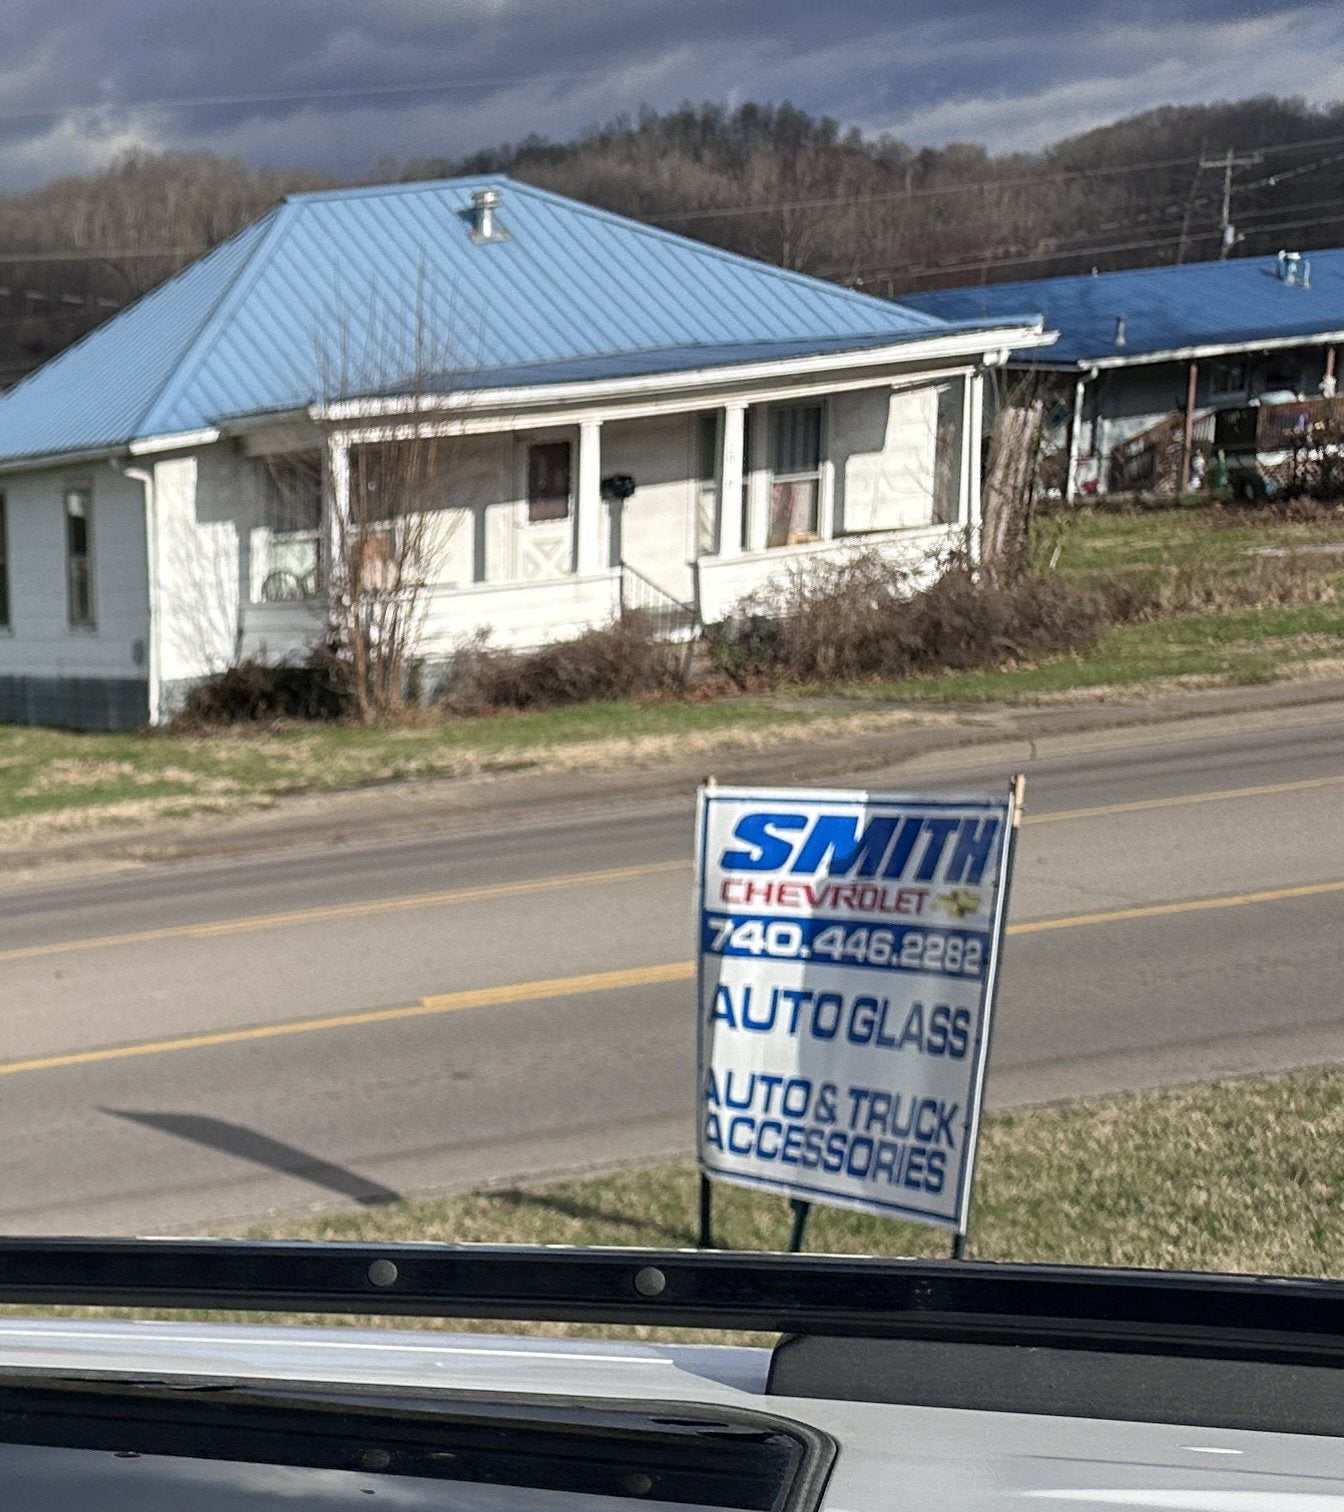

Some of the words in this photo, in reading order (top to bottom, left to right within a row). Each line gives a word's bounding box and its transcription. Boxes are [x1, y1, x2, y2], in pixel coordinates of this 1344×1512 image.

[720, 813, 999, 885] SMITH
[720, 878, 930, 915] CHEVROLET
[708, 917, 982, 971] 740.446.2282
[714, 985, 843, 1040] AUTO
[848, 993, 971, 1058] GLASS
[706, 1069, 811, 1118] AUTO
[814, 1083, 838, 1125] &
[848, 1088, 958, 1149] TRUCK
[706, 1113, 947, 1194] ACCESSORIES
